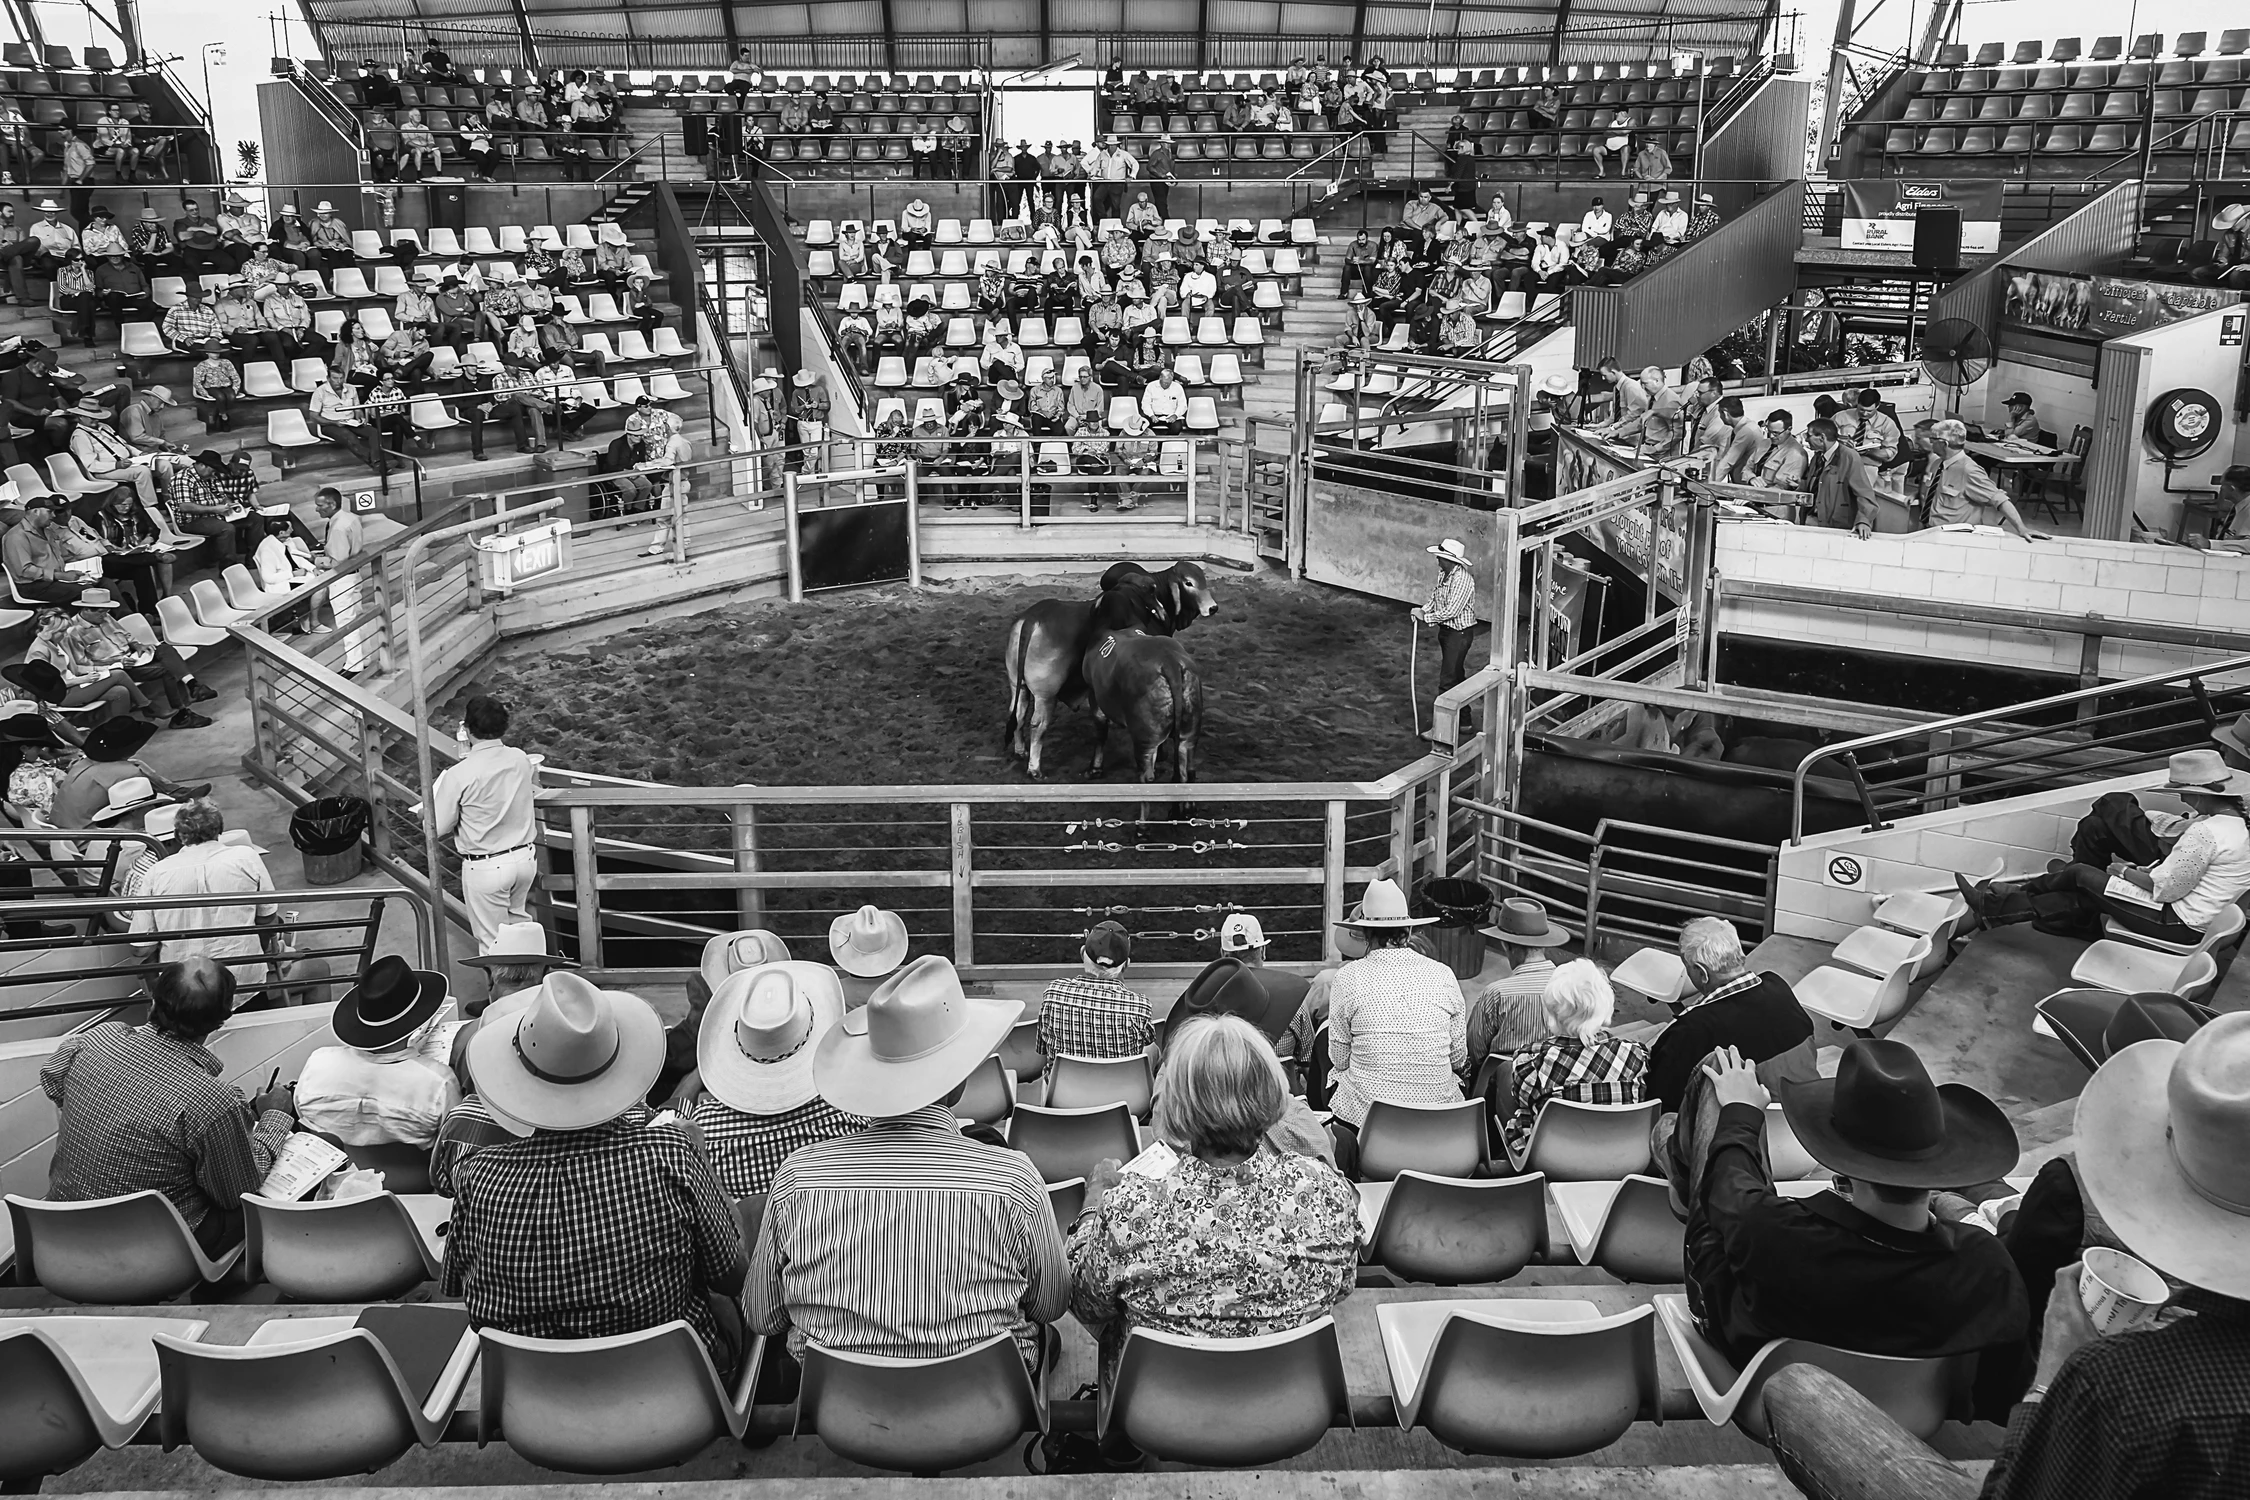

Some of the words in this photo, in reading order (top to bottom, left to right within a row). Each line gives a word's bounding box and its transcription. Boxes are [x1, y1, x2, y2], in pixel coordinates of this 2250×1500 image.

[1905, 186, 1938, 197] Elders
[1895, 202, 1913, 211] Agri
[2104, 284, 2148, 301] Efficient
[2161, 291, 2217, 310] Adaptable
[2103, 310, 2137, 326] Fertile
[1616, 535, 1635, 560] your
[523, 542, 554, 573] EXIT
[956, 804, 965, 859] RUBBISH
[2087, 1295, 2107, 1318] Delicious
